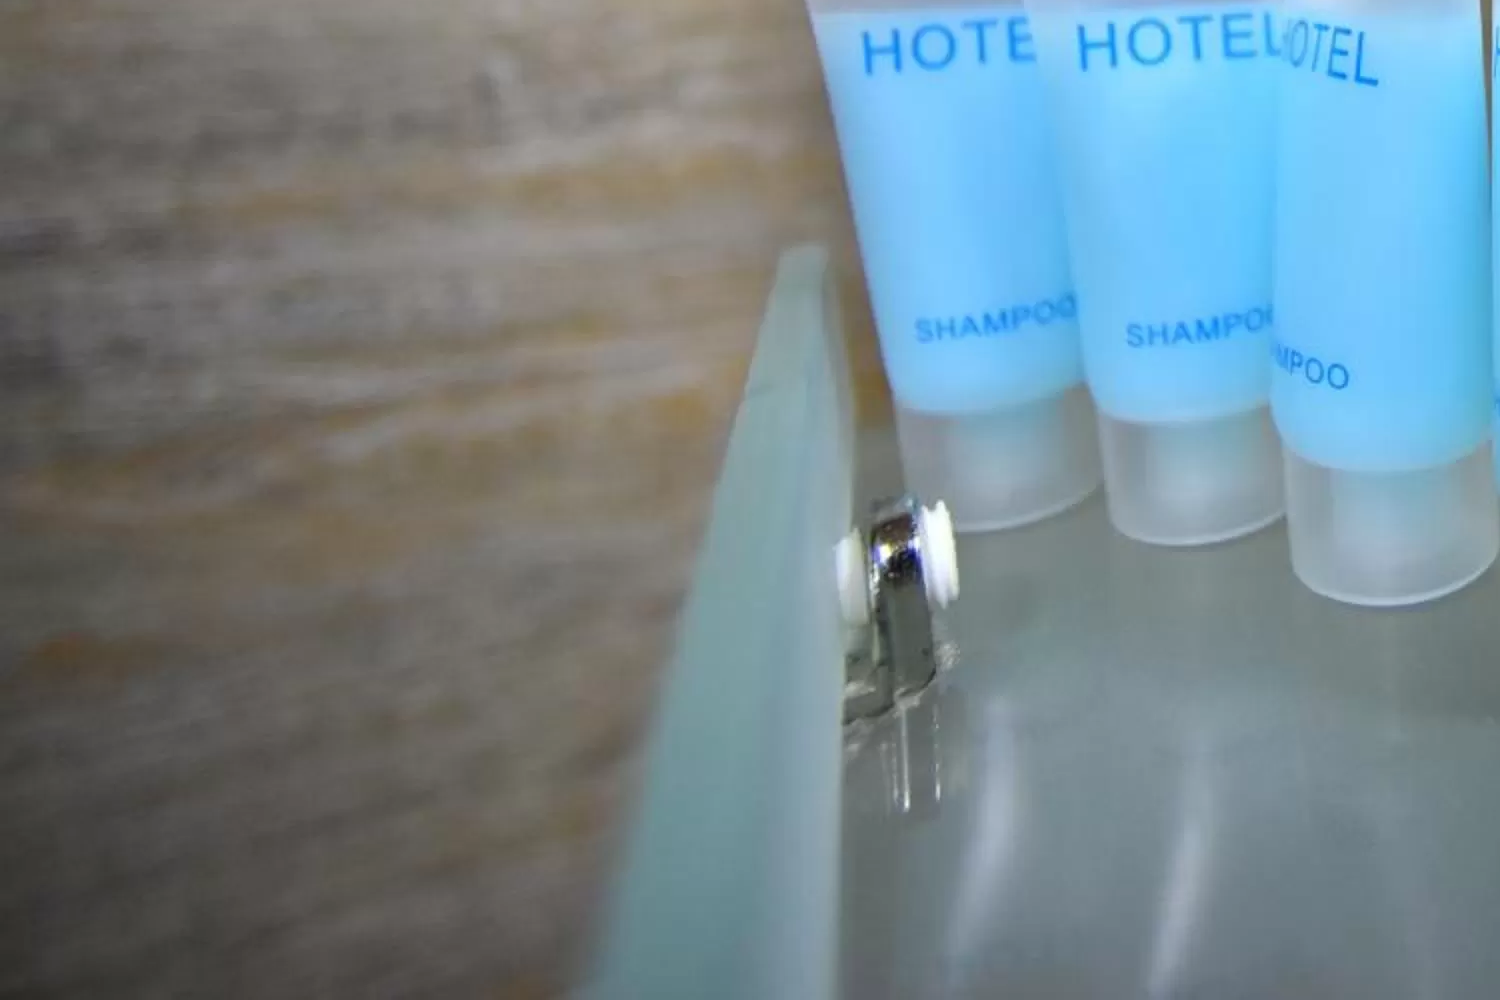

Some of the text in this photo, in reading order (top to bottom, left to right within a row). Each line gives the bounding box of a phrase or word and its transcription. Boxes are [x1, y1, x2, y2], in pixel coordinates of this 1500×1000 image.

[863, 15, 1038, 77] HOTE
[1077, 9, 1284, 72] HOTEL
[1285, 18, 1379, 87] OTEL
